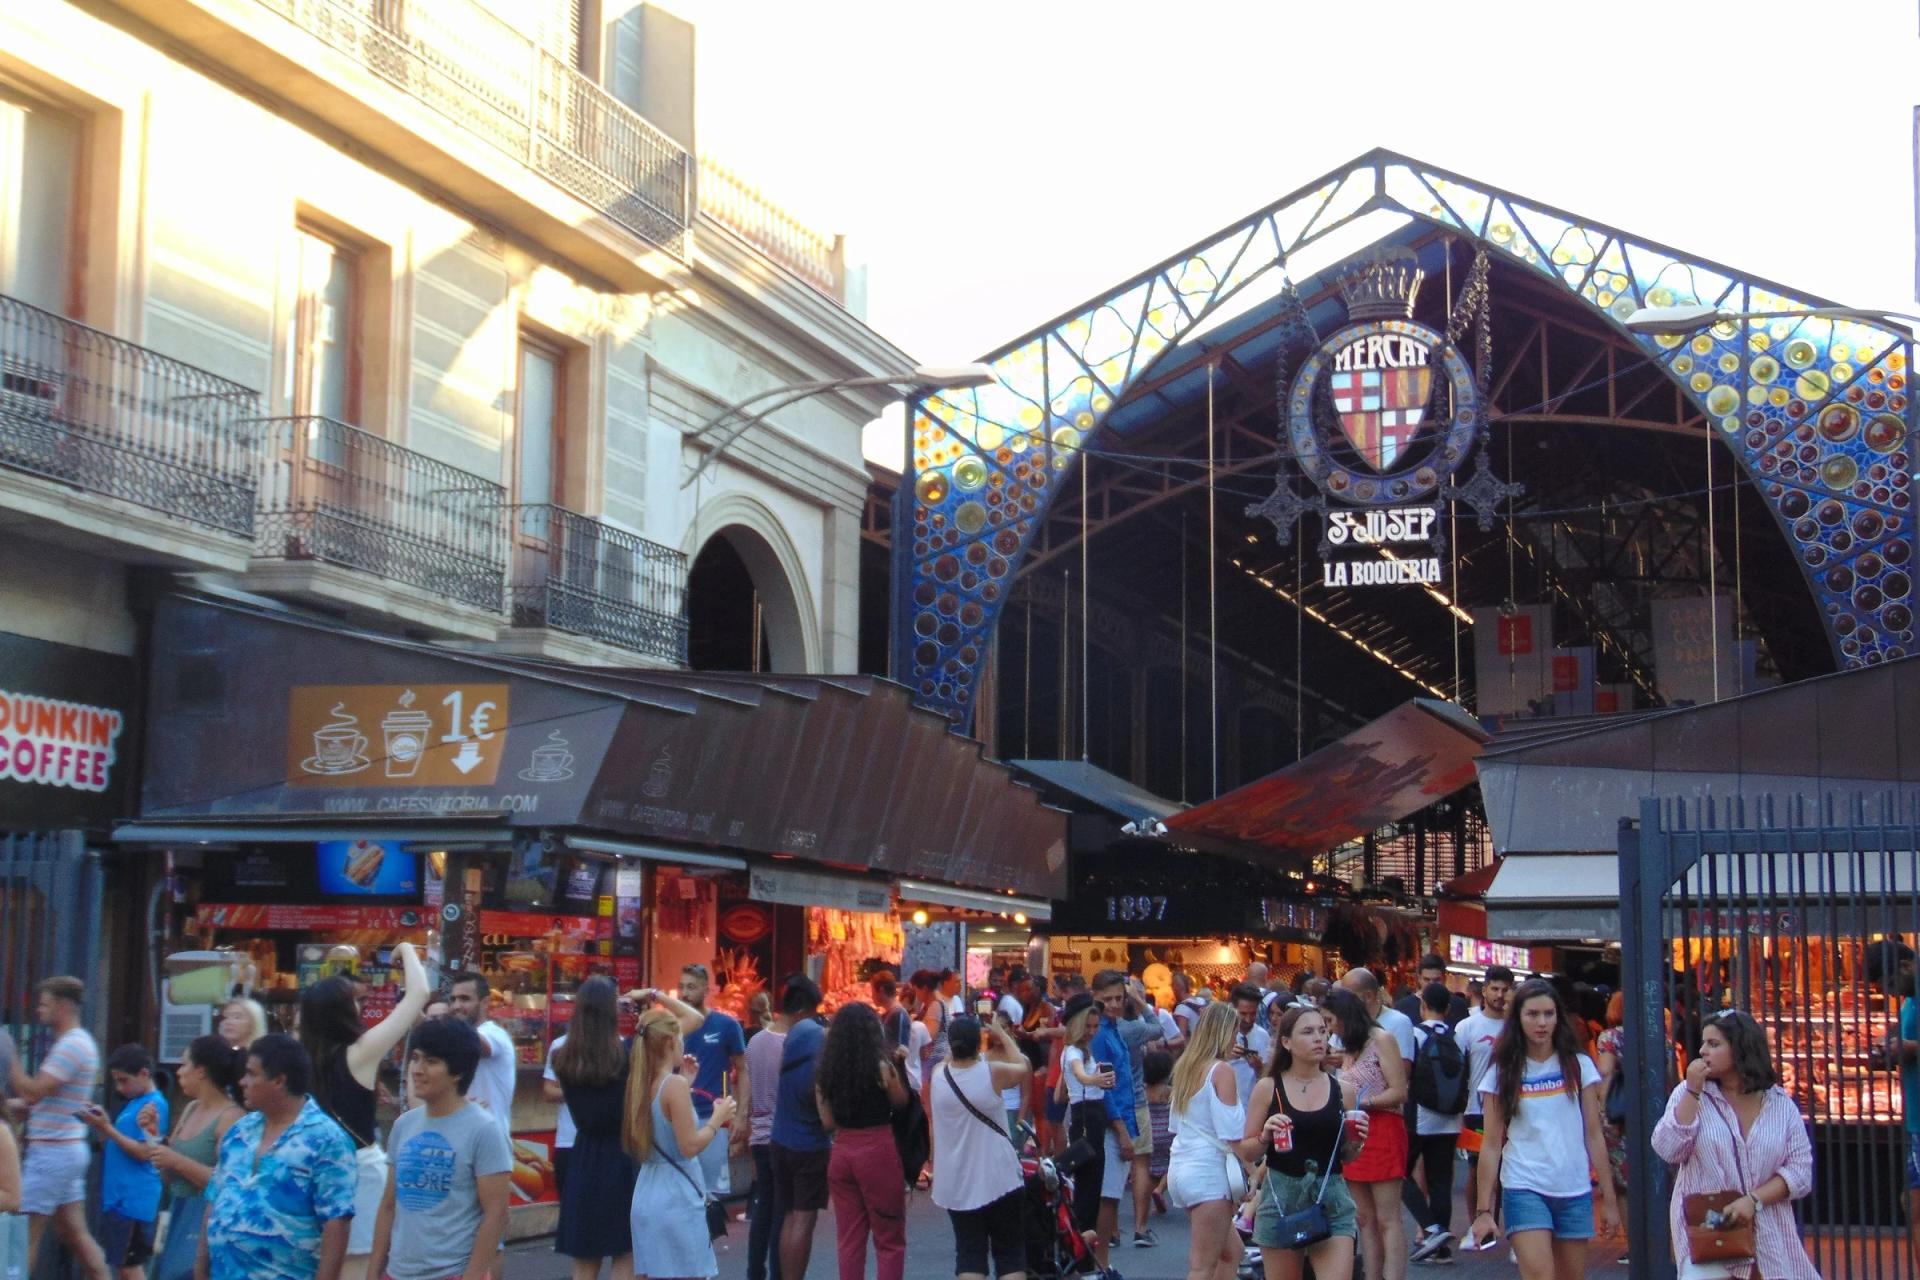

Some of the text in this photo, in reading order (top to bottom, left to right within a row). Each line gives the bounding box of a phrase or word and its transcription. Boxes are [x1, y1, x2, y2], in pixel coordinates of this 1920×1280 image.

[1335, 334, 1429, 372] MERCAT
[1352, 507, 1436, 543] JOSEP
[1323, 558, 1441, 588] LA BOQUERIA
[441, 690, 496, 742] 1€
[1106, 895, 1168, 921] 1897
[1522, 1079, 1565, 1092] Rainbo
